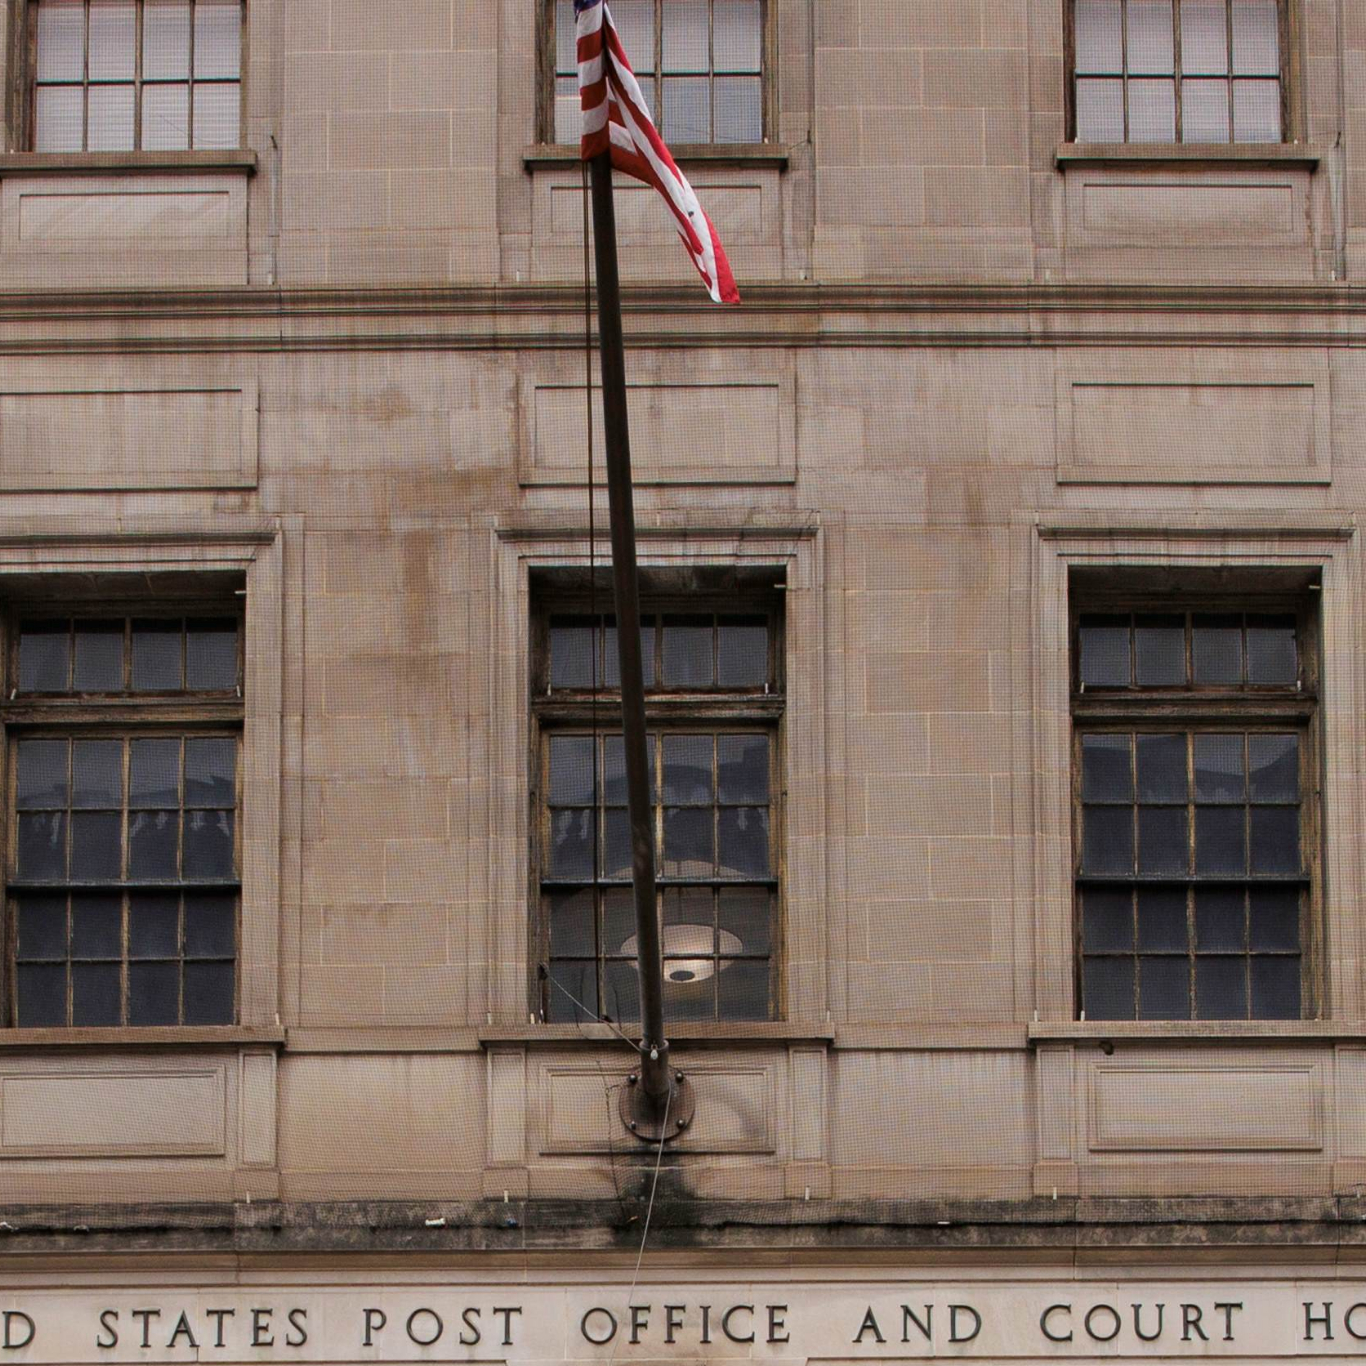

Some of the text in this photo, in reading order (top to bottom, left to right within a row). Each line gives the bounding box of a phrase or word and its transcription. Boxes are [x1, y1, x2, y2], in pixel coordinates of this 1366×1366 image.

[96, 1307, 308, 1350] STATES
[362, 1306, 523, 1348] POST
[579, 1304, 791, 1346] OFFICE
[852, 1303, 983, 1344] AND
[1039, 1302, 1243, 1343] COURT
